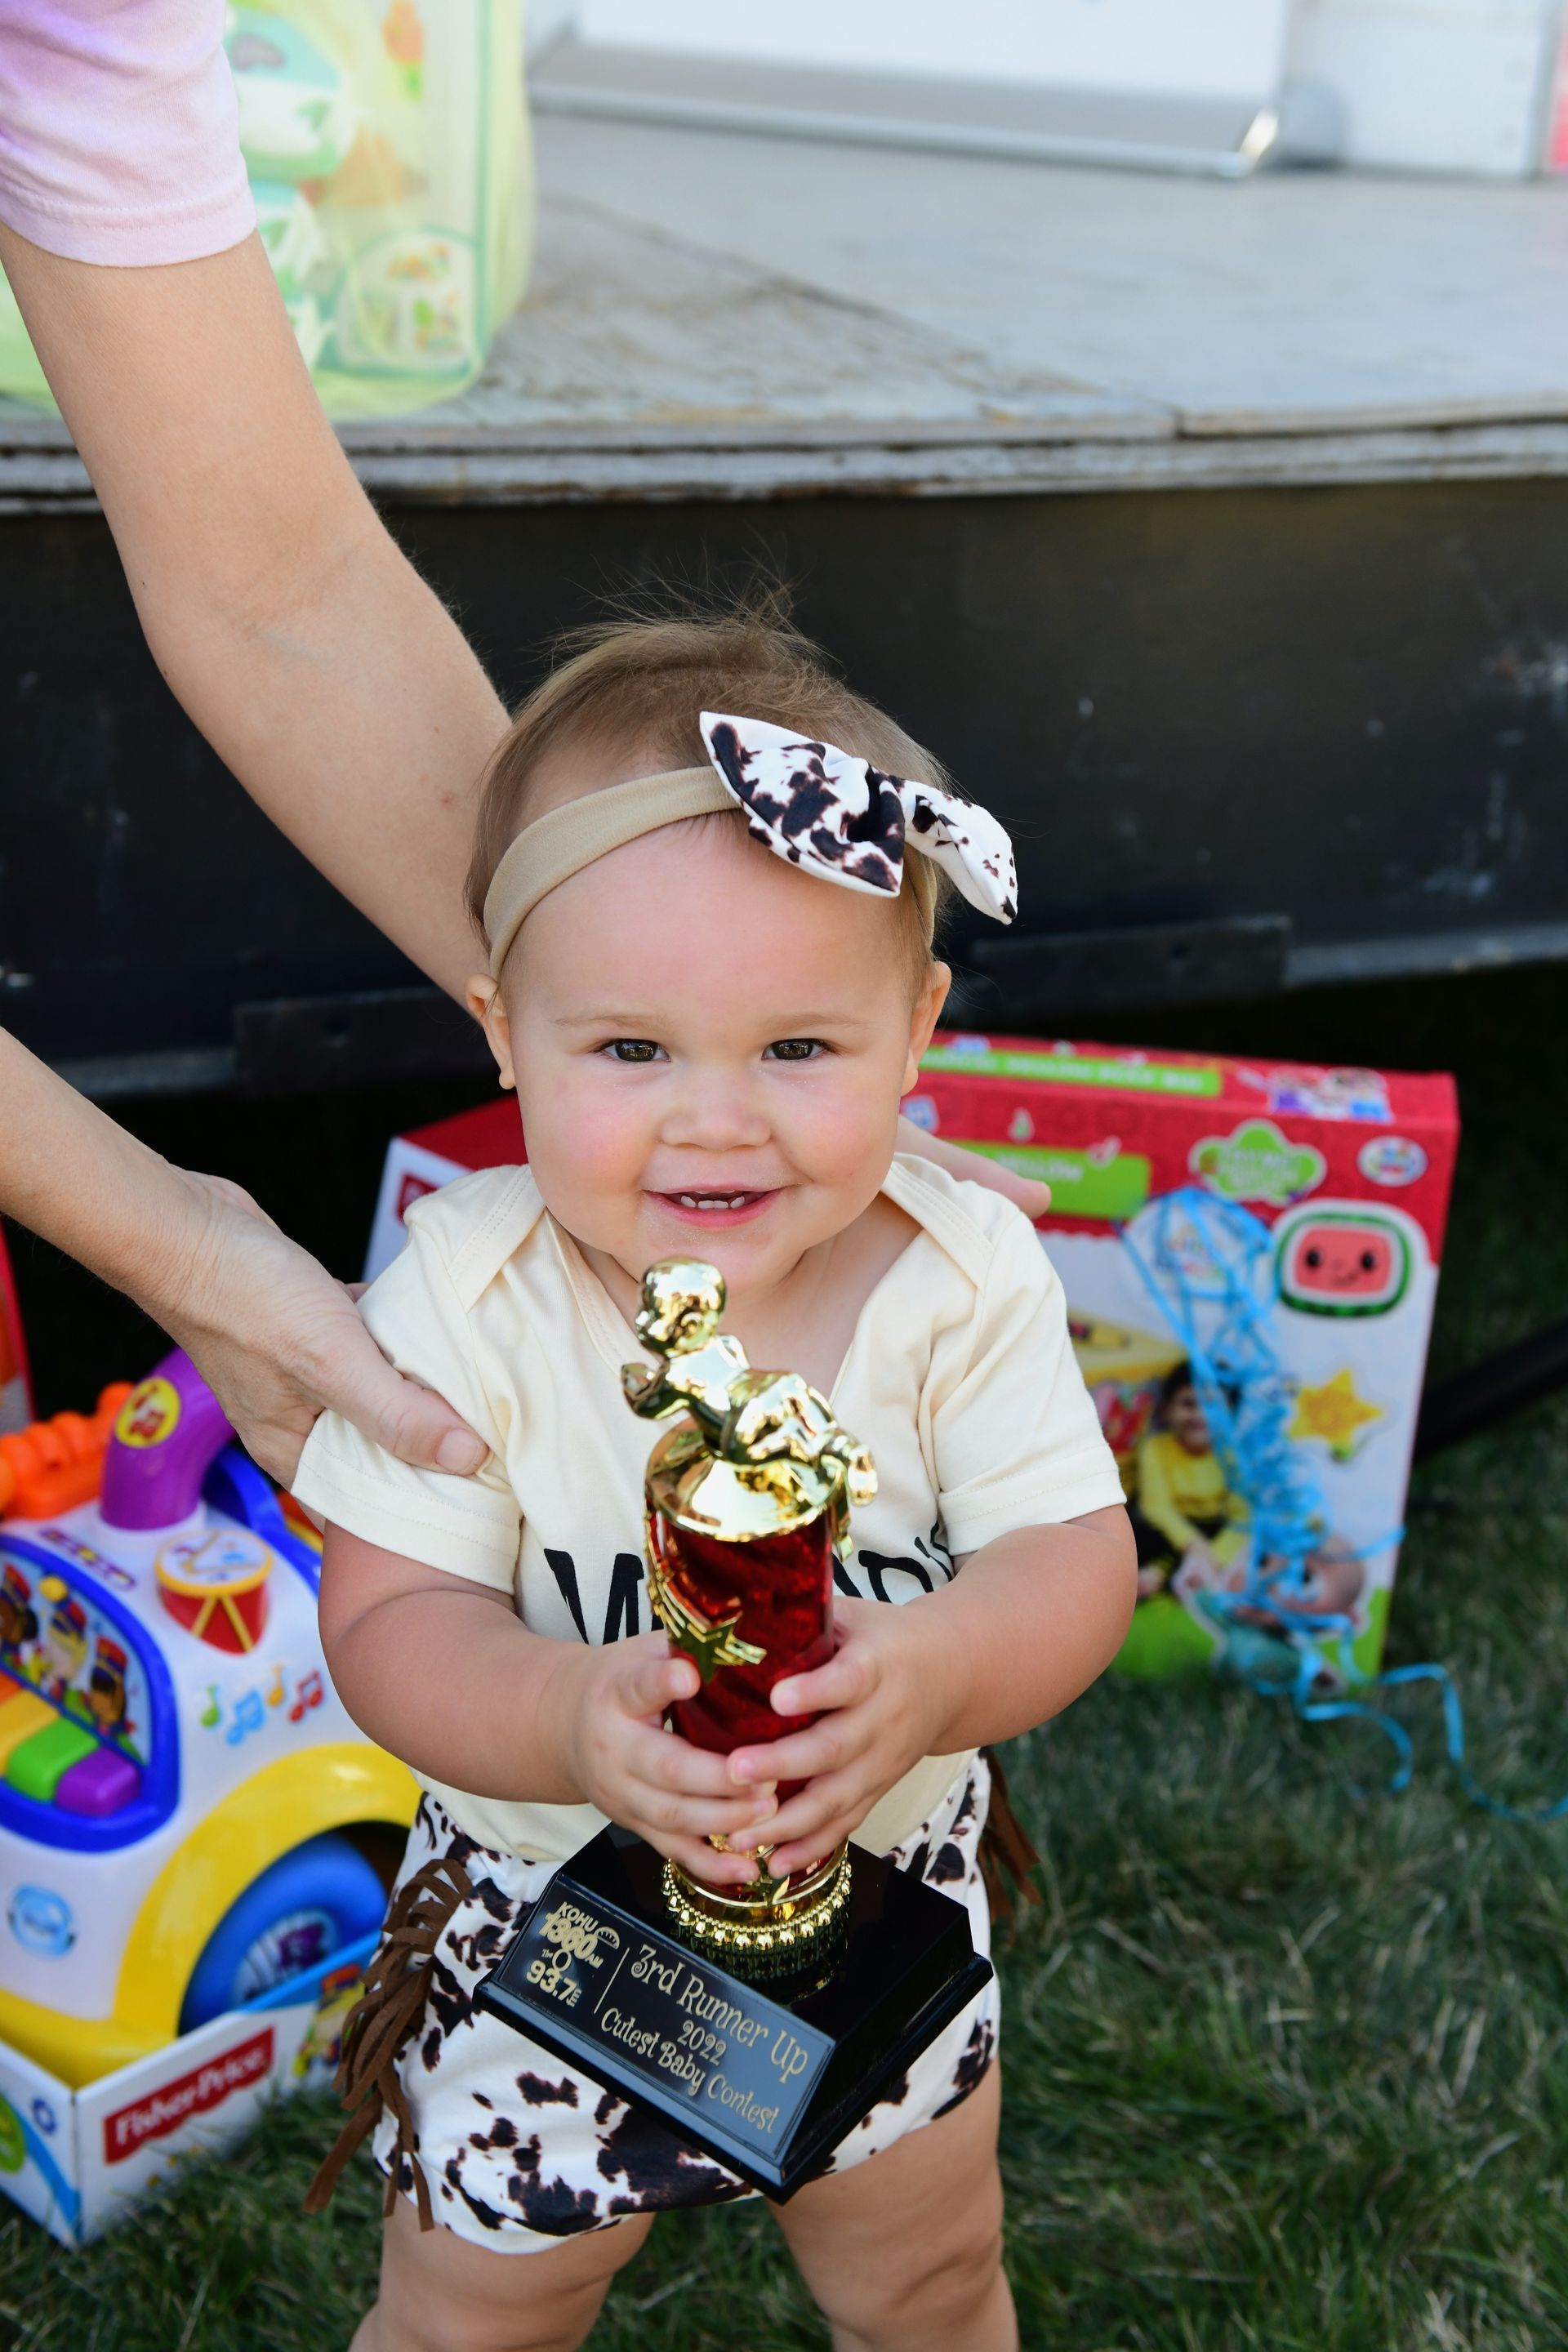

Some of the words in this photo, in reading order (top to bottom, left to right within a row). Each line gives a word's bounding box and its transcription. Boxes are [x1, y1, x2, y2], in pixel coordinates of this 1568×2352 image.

[555, 1901, 599, 1932] KOHU
[526, 1960, 577, 2001] 93.7
[630, 1944, 686, 1996] 3rd
[676, 1974, 768, 2048] Runner
[770, 2029, 808, 2084] Up
[677, 2020, 726, 2066] 2022
[601, 2007, 660, 2058] Cutest
[657, 2041, 706, 2096] Baby
[707, 2074, 779, 2133] Contest
